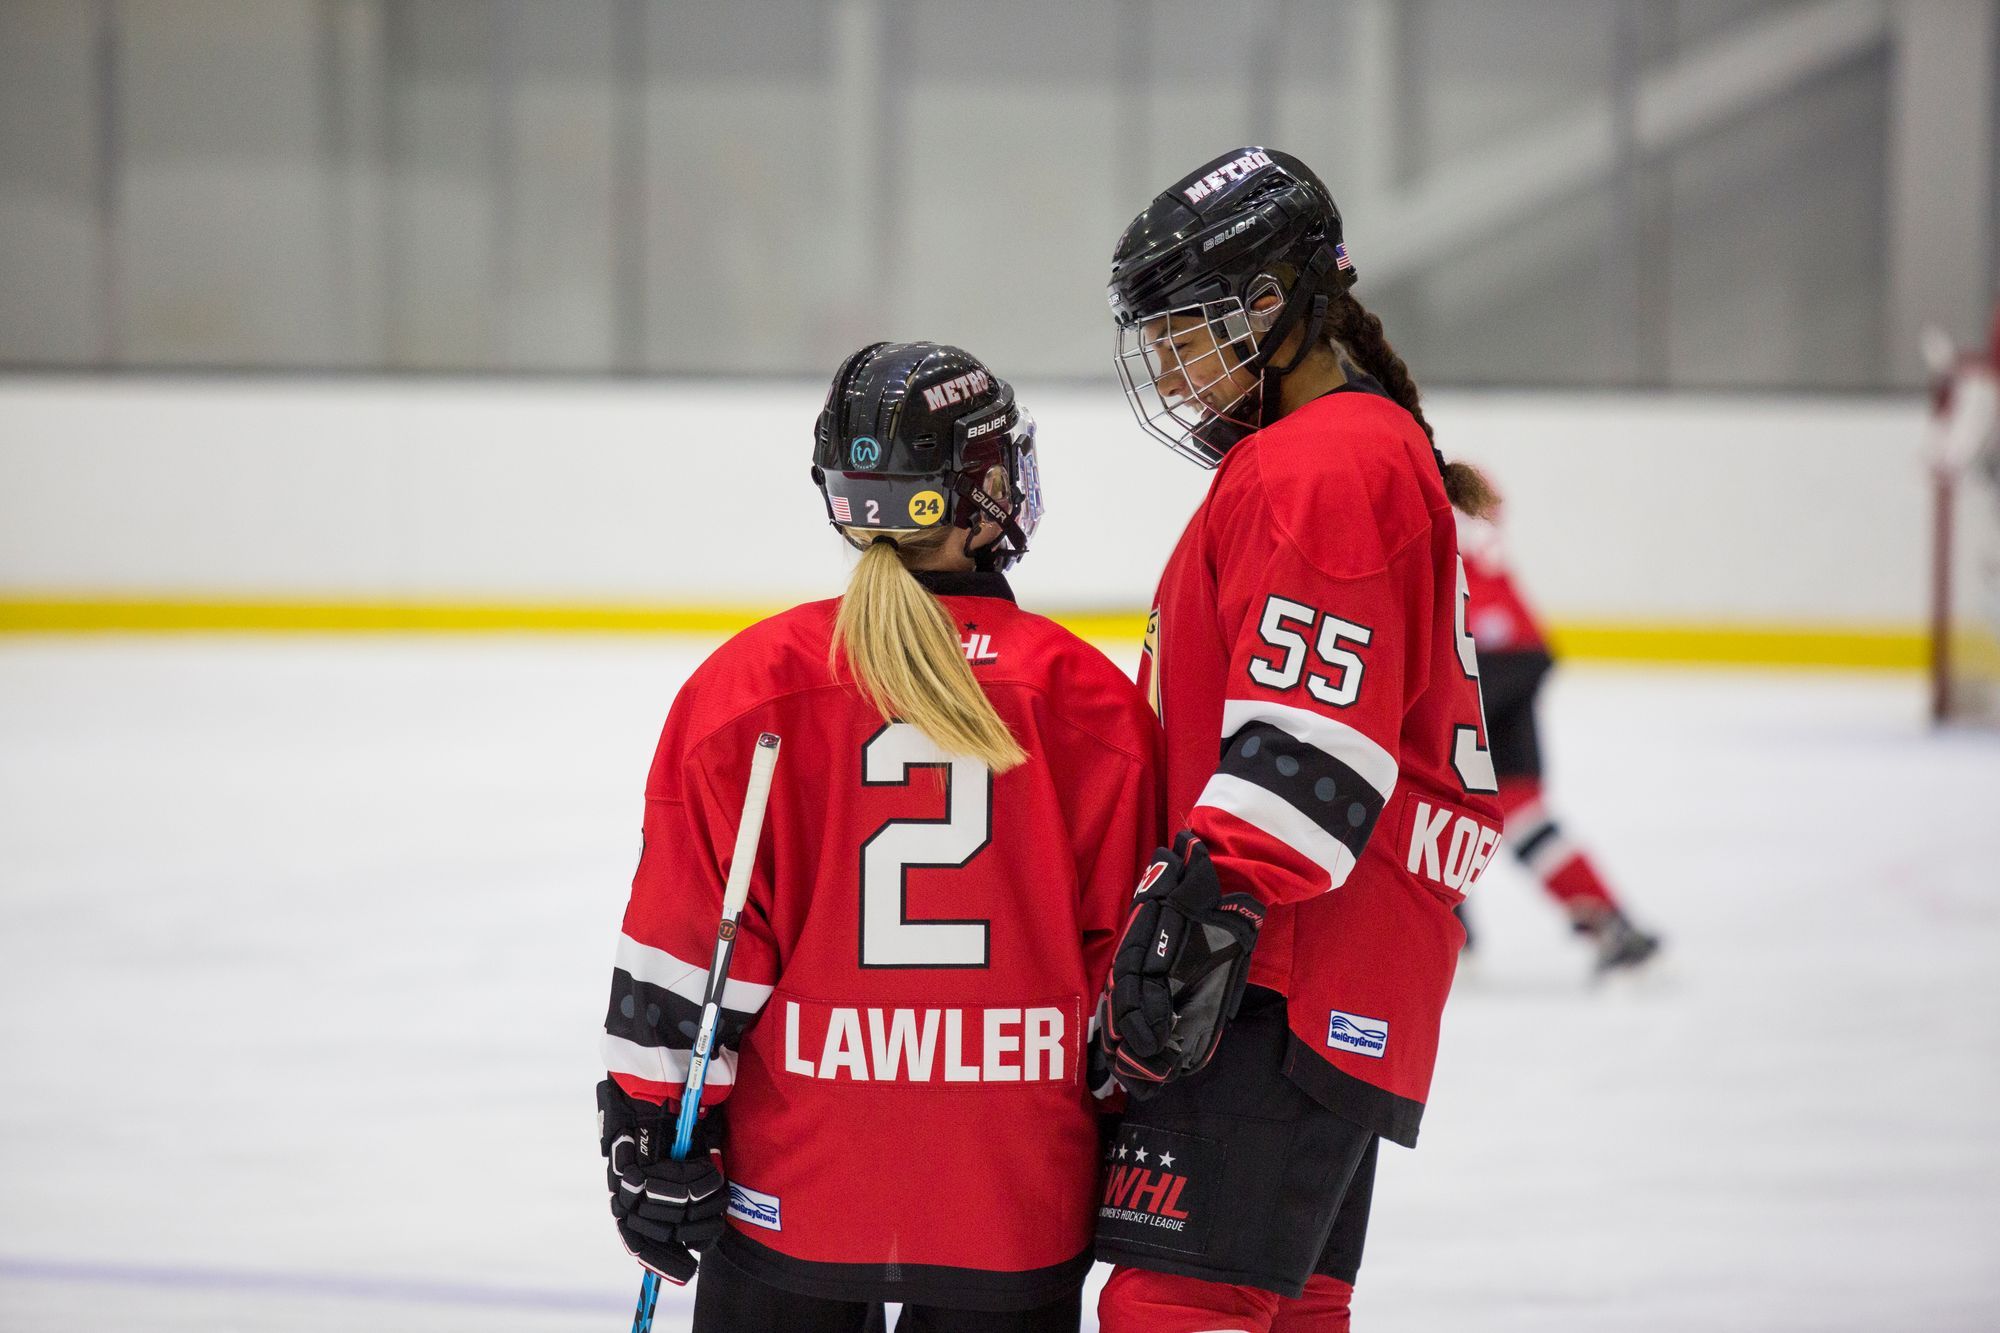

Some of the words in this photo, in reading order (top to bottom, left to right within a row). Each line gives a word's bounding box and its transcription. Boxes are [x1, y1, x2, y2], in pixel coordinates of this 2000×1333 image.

[1184, 151, 1273, 204] METRO
[1203, 215, 1257, 251] BAUER
[922, 369, 989, 412] METRO
[967, 415, 1007, 438] BAUER
[865, 500, 880, 523] 2
[914, 499, 939, 516] 24
[971, 487, 1007, 523] AUER
[960, 633, 998, 659] HL
[1248, 594, 1374, 708] 55
[859, 718, 992, 969] 2
[1407, 801, 1502, 897] KOE
[785, 1001, 1064, 1082] LAWLER
[1331, 1030, 1383, 1050] MeiGrayGroup
[1104, 1164, 1189, 1219] WHL
[1120, 1210, 1150, 1224] HOCKEY
[1150, 1215, 1186, 1232] LEAGUE
